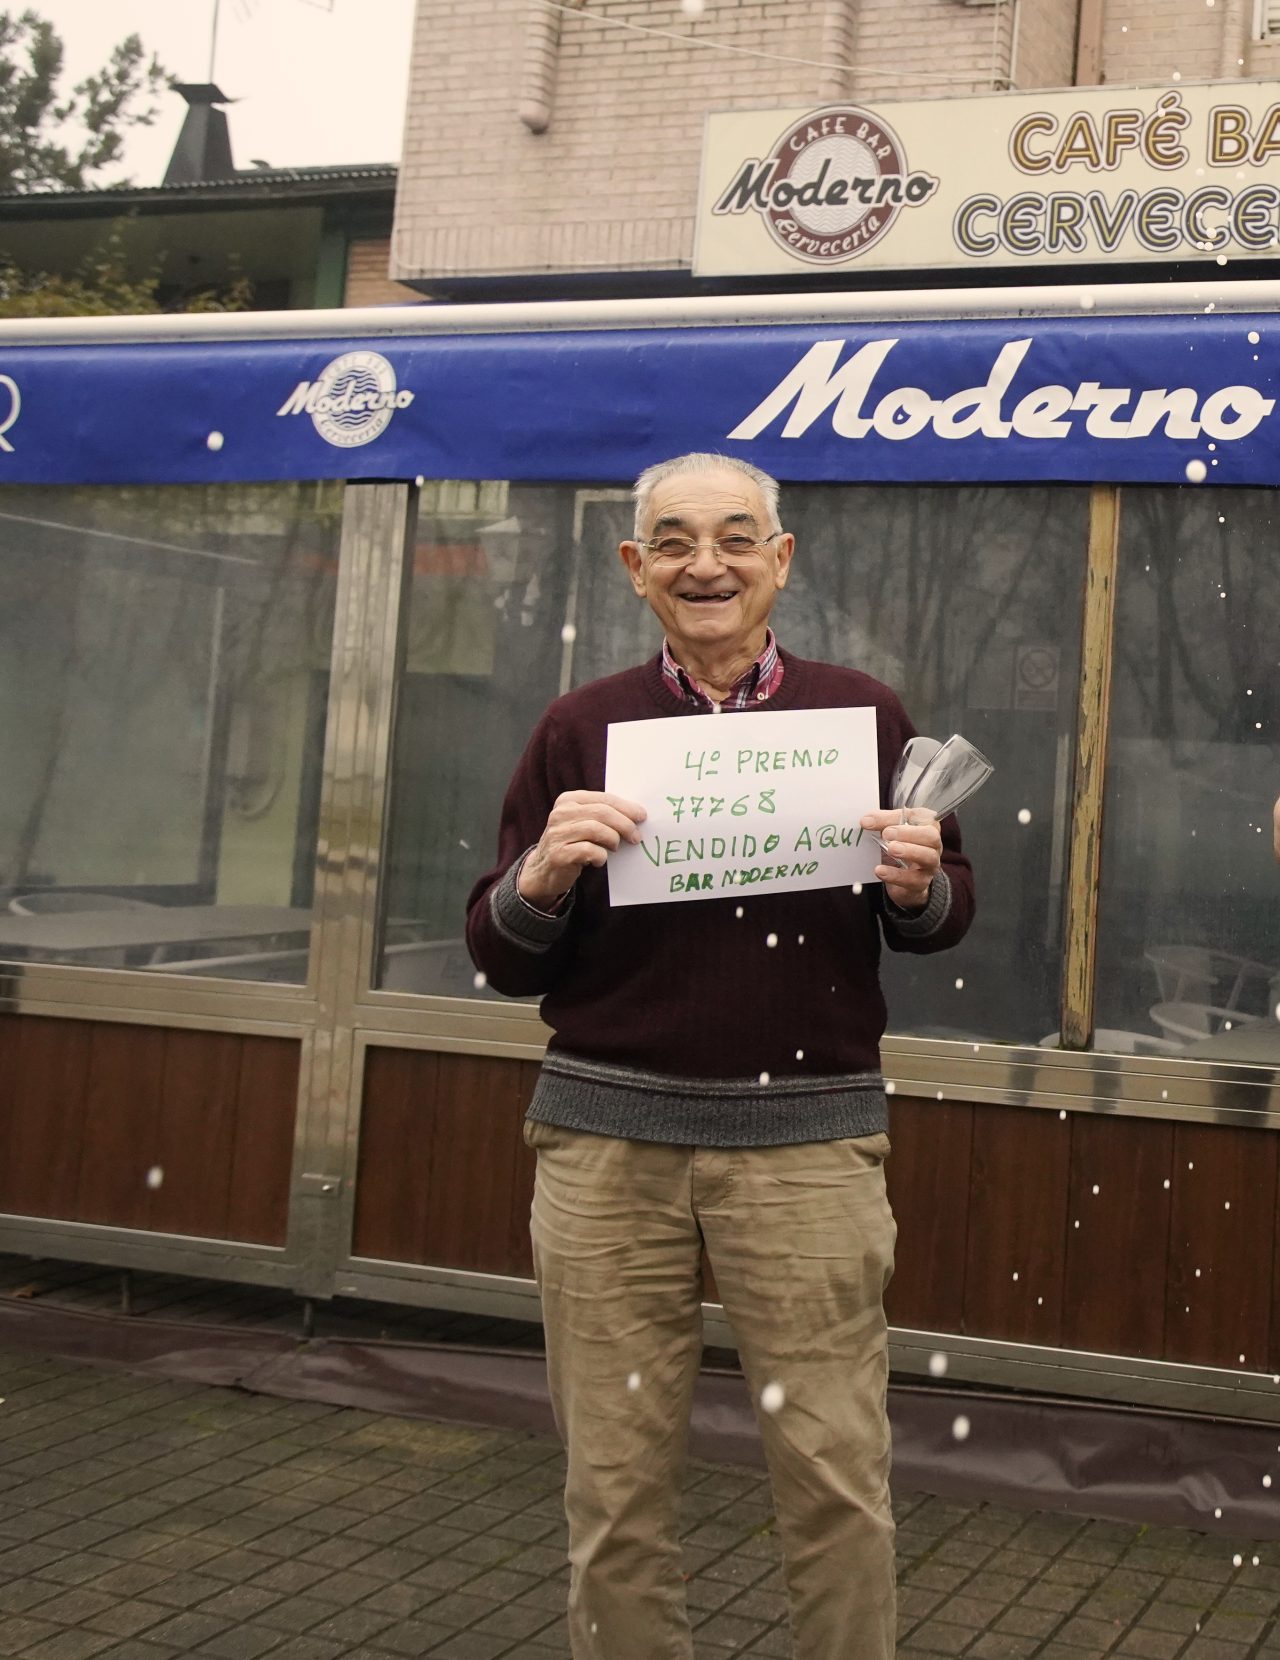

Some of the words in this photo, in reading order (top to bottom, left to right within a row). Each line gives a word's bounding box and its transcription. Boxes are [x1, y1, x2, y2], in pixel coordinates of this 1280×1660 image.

[855, 121, 892, 160] BAR
[1011, 91, 1189, 173] CAFÉ
[715, 157, 937, 211] Moderno
[275, 379, 415, 416] Moderno
[726, 337, 1276, 441] Moderno
[737, 748, 839, 774] PREMIO
[666, 788, 776, 823] 77768
[640, 834, 780, 867] VENDIDO
[793, 823, 864, 852] AQUI
[669, 872, 714, 893] BAR
